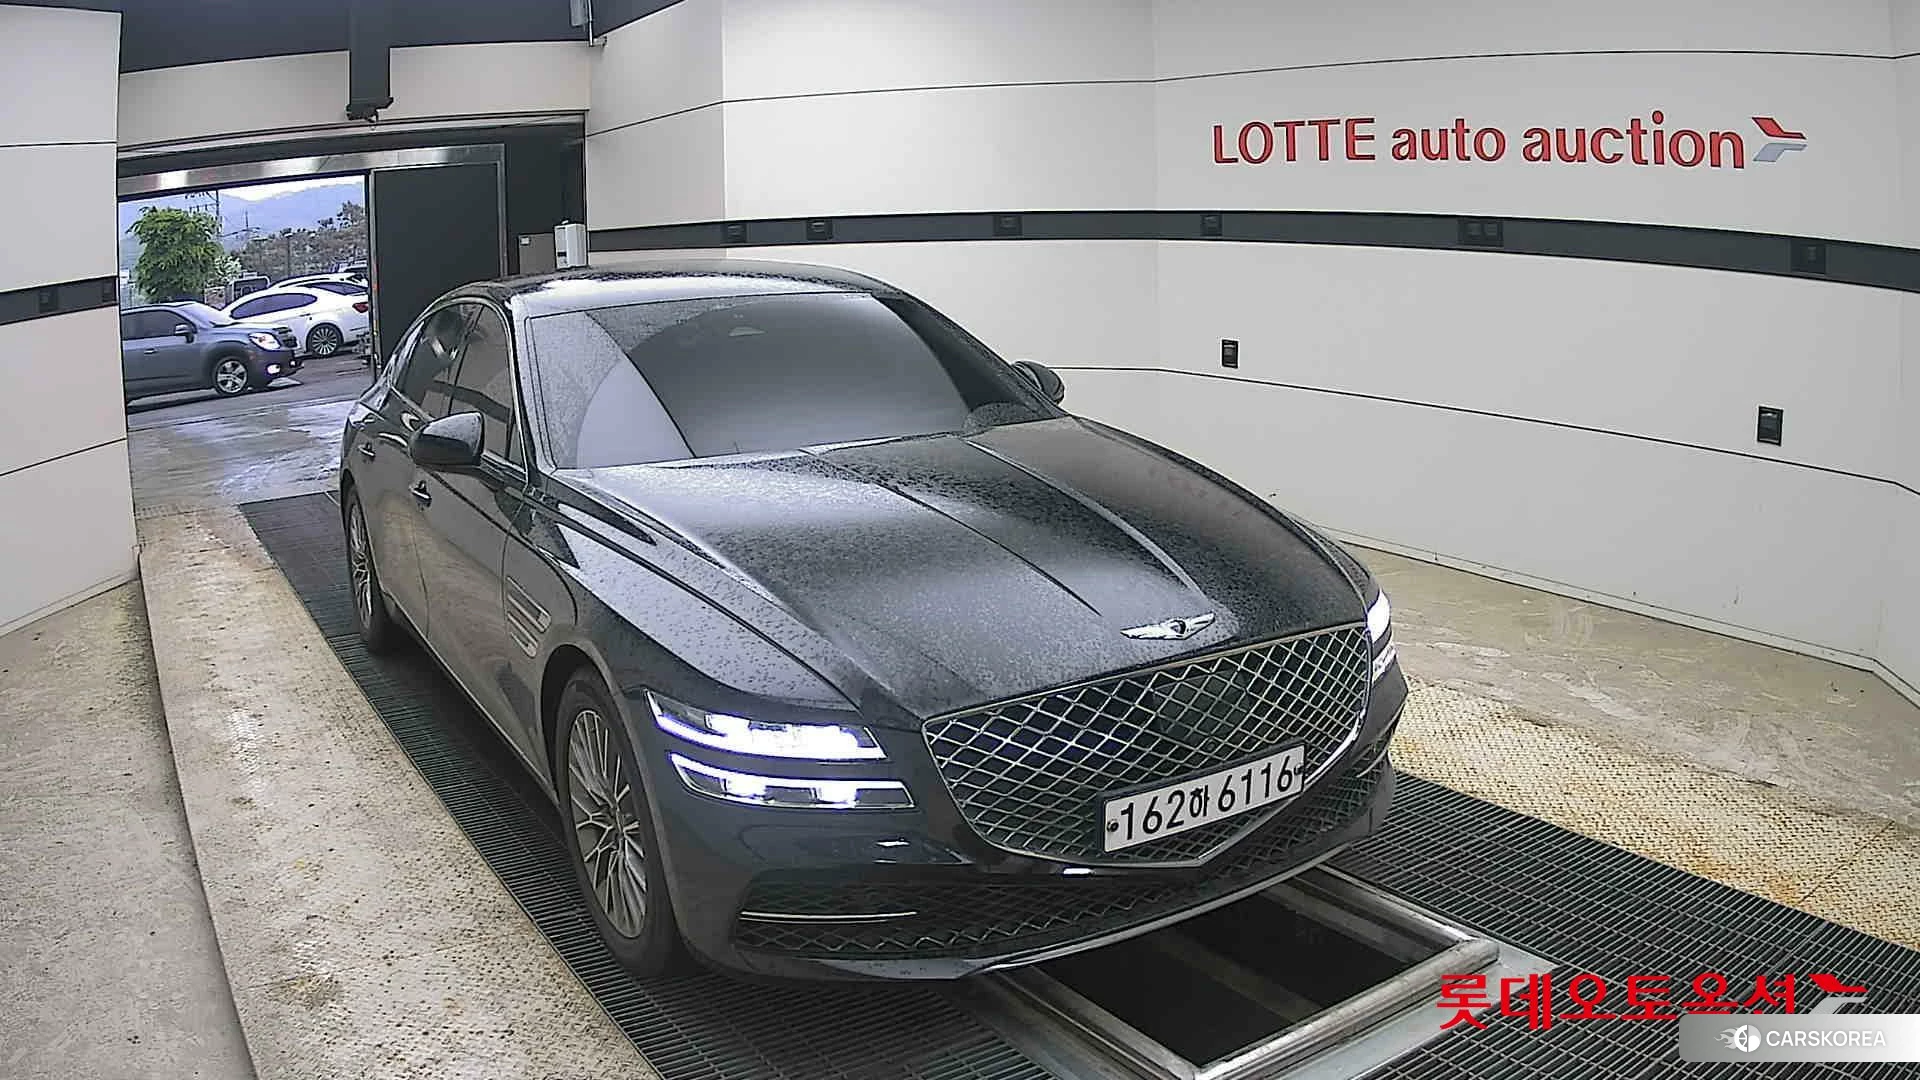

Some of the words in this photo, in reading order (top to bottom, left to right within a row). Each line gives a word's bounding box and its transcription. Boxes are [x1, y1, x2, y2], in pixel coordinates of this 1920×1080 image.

[1212, 117, 1376, 164] LOTTE
[1390, 118, 1506, 162] auto
[1522, 110, 1745, 169] auction
[1120, 784, 1210, 840] 162하
[1217, 755, 1293, 812] 6116
